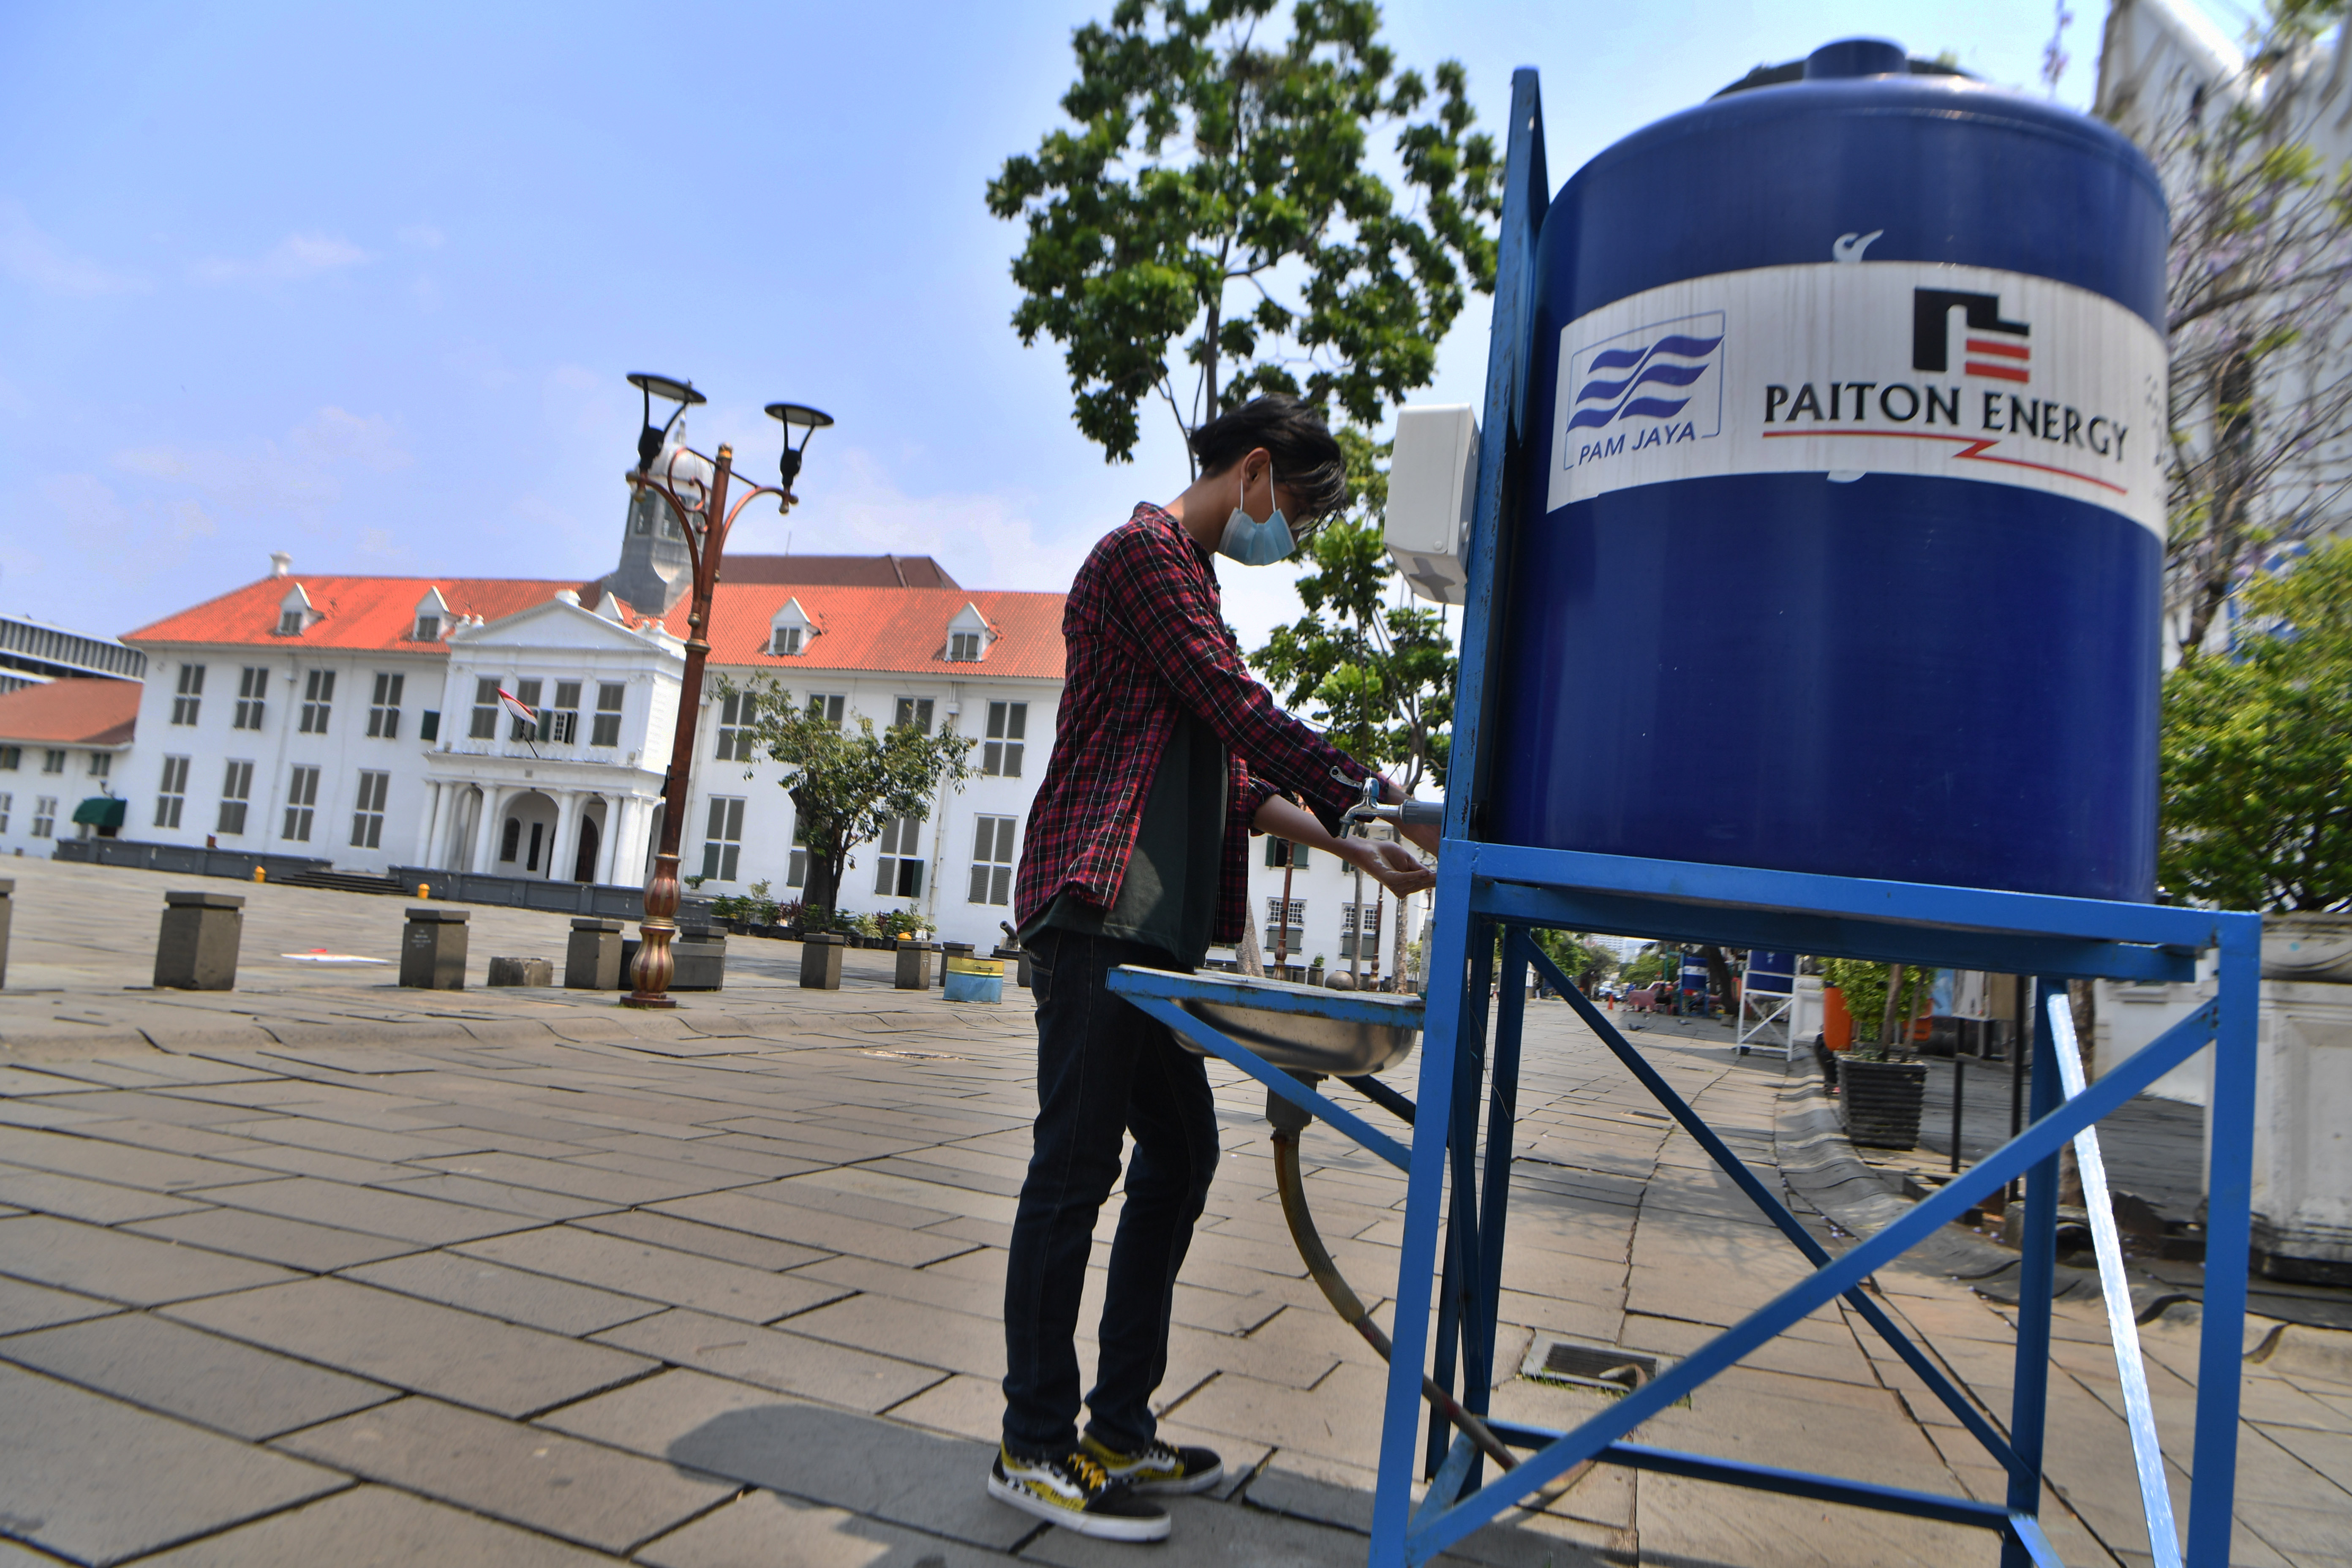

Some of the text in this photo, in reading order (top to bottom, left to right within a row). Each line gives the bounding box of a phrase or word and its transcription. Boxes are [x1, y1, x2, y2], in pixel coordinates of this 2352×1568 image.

[1578, 421, 1696, 466] PAM JAYA
[1764, 381, 1961, 425] PAITON
[1982, 391, 2129, 462] ENERGY
